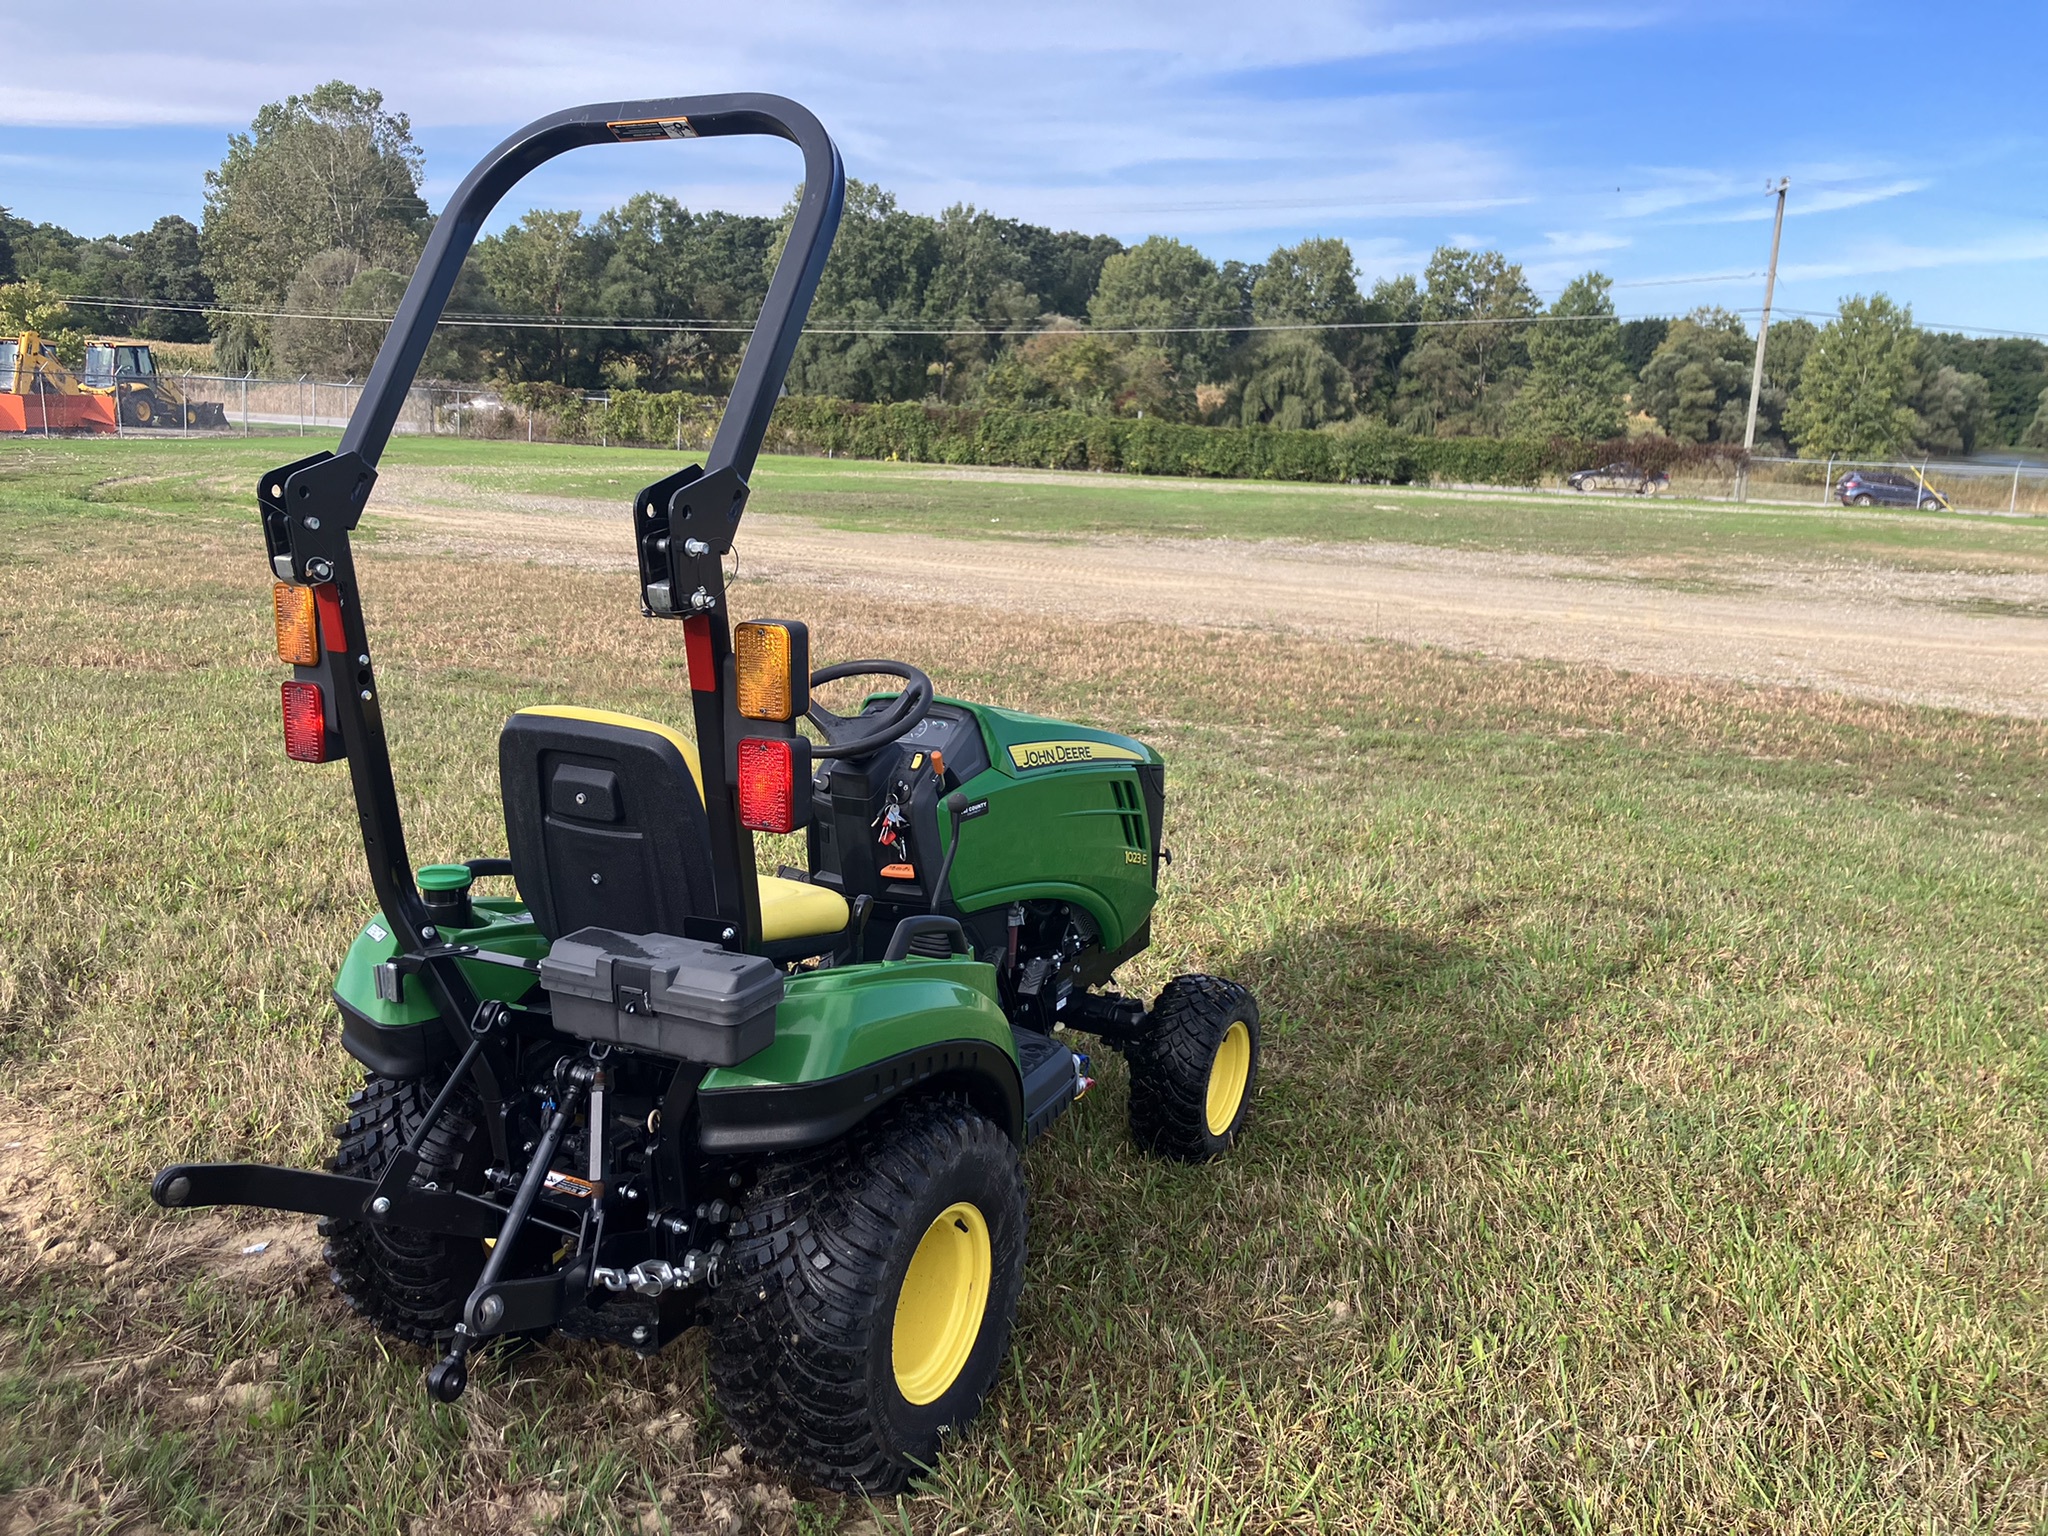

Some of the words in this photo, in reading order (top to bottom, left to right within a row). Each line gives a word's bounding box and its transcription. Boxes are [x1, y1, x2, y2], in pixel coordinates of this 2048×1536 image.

[1023, 749, 1055, 766] JOHN
[1055, 745, 1092, 761] DEERE
[1125, 850, 1141, 864] 1023
[1142, 853, 1147, 865] E
